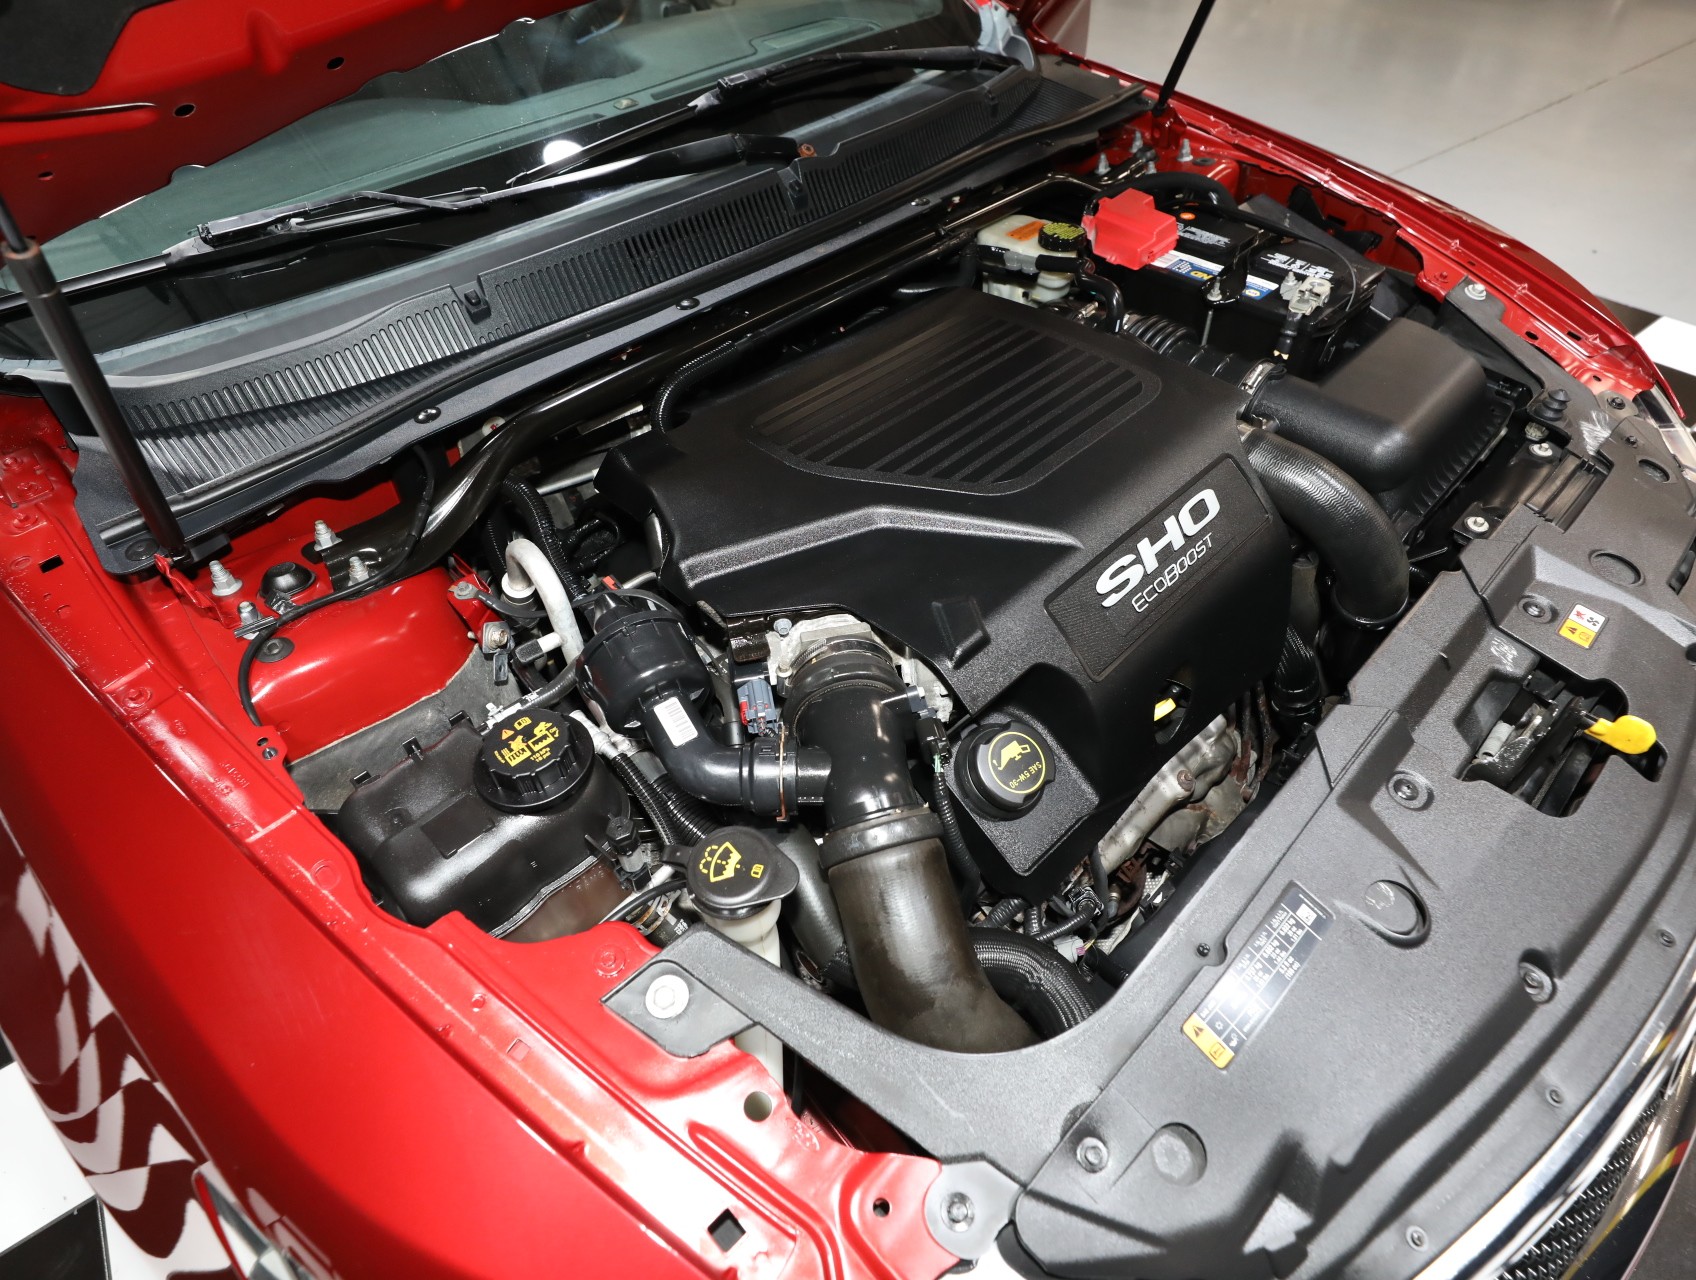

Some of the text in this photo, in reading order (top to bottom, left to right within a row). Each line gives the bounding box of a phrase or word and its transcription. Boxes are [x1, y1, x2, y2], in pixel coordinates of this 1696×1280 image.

[1096, 488, 1220, 608] SHO
[1009, 761, 1042, 788] SAE 5W-30
